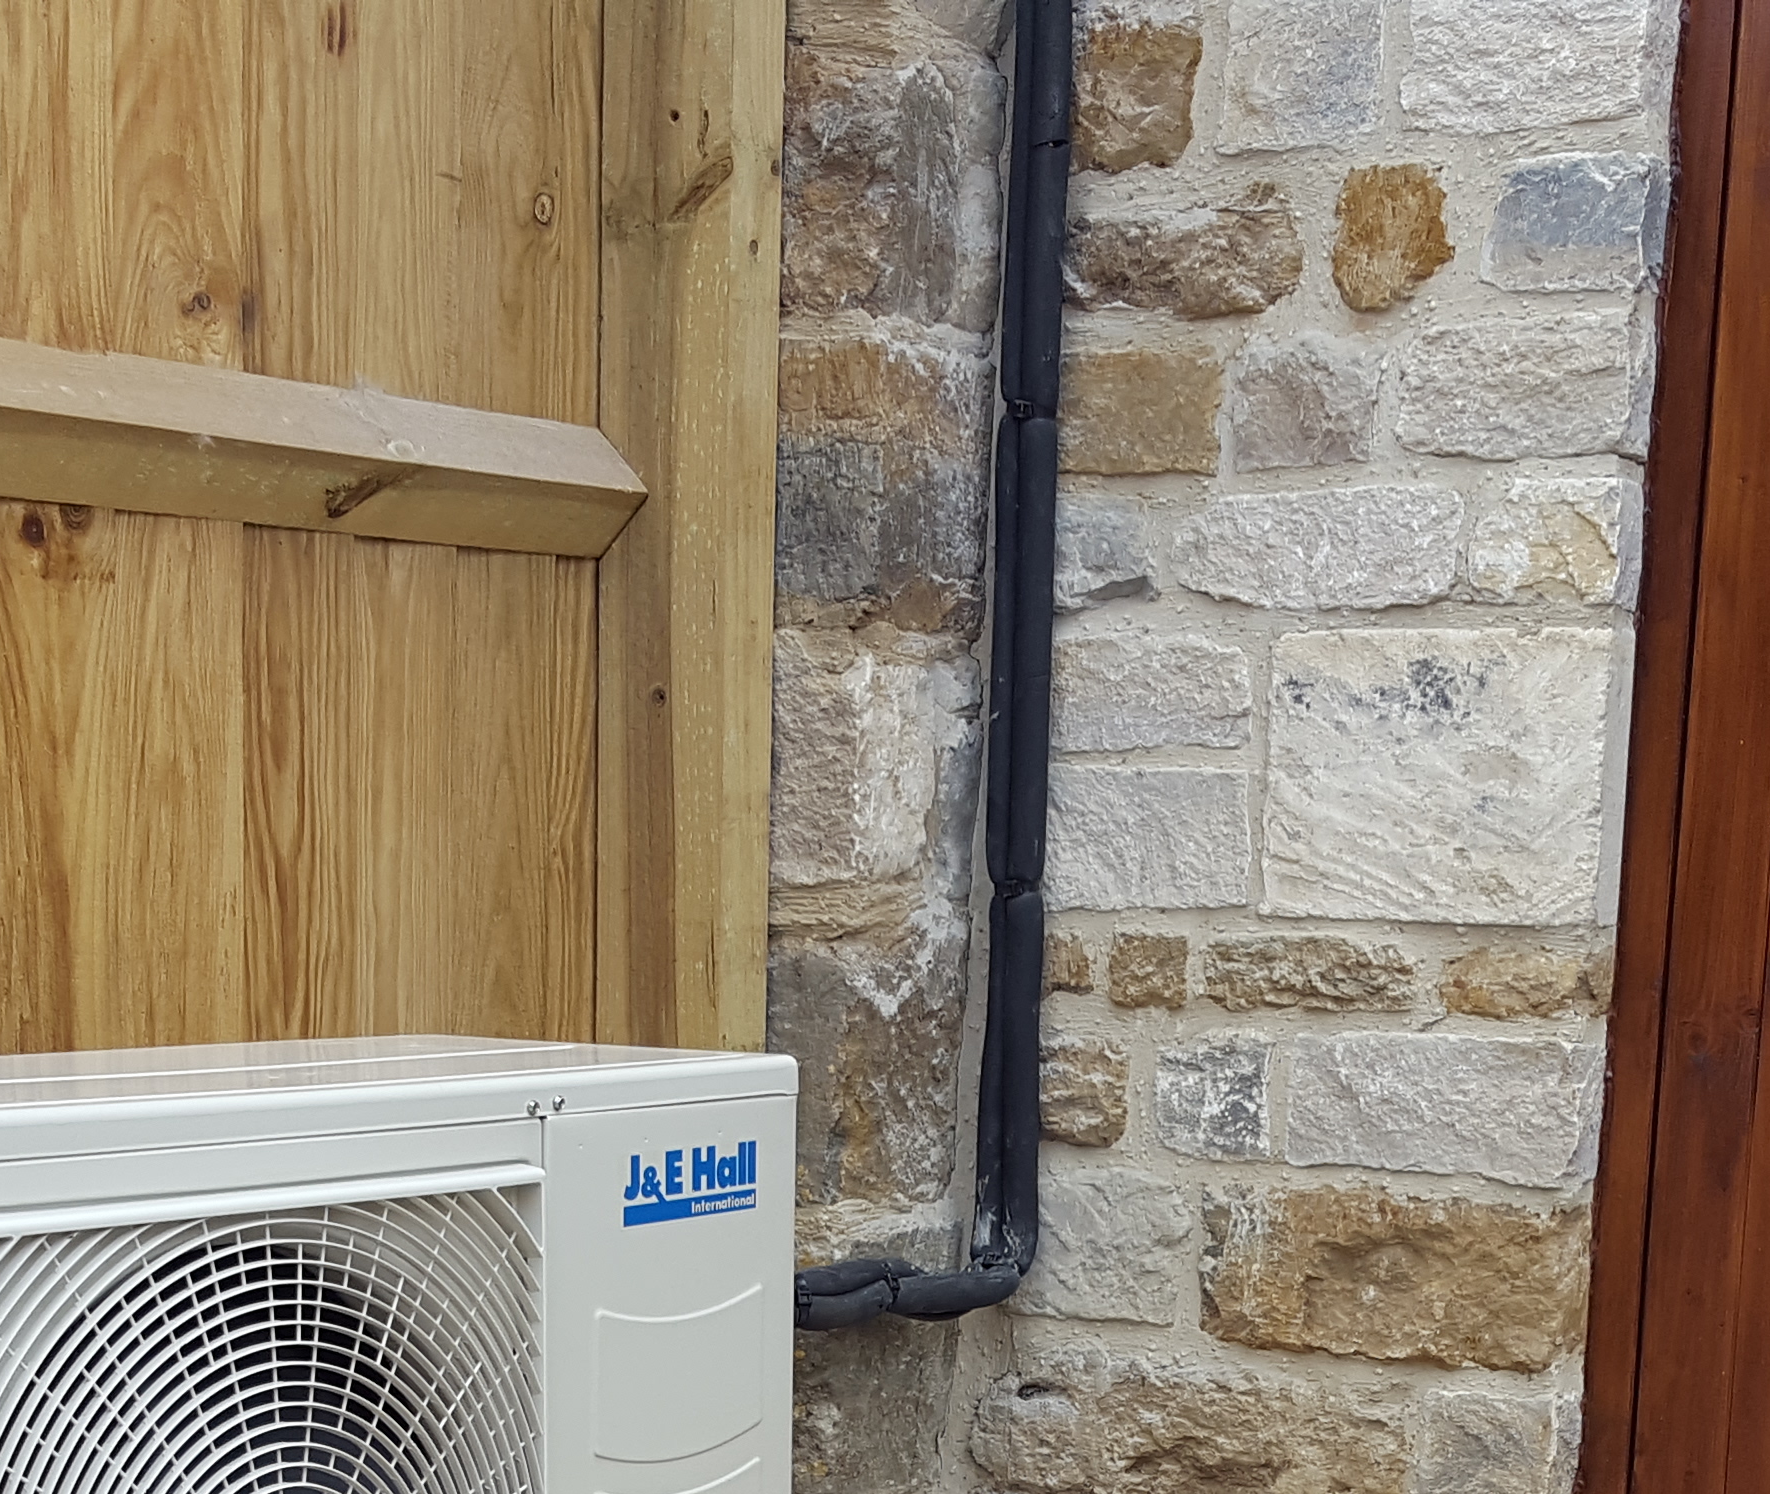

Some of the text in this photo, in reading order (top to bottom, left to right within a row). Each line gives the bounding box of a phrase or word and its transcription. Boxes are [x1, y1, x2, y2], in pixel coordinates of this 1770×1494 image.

[623, 1140, 757, 1201] J&E Hall
[691, 1193, 755, 1214] International
